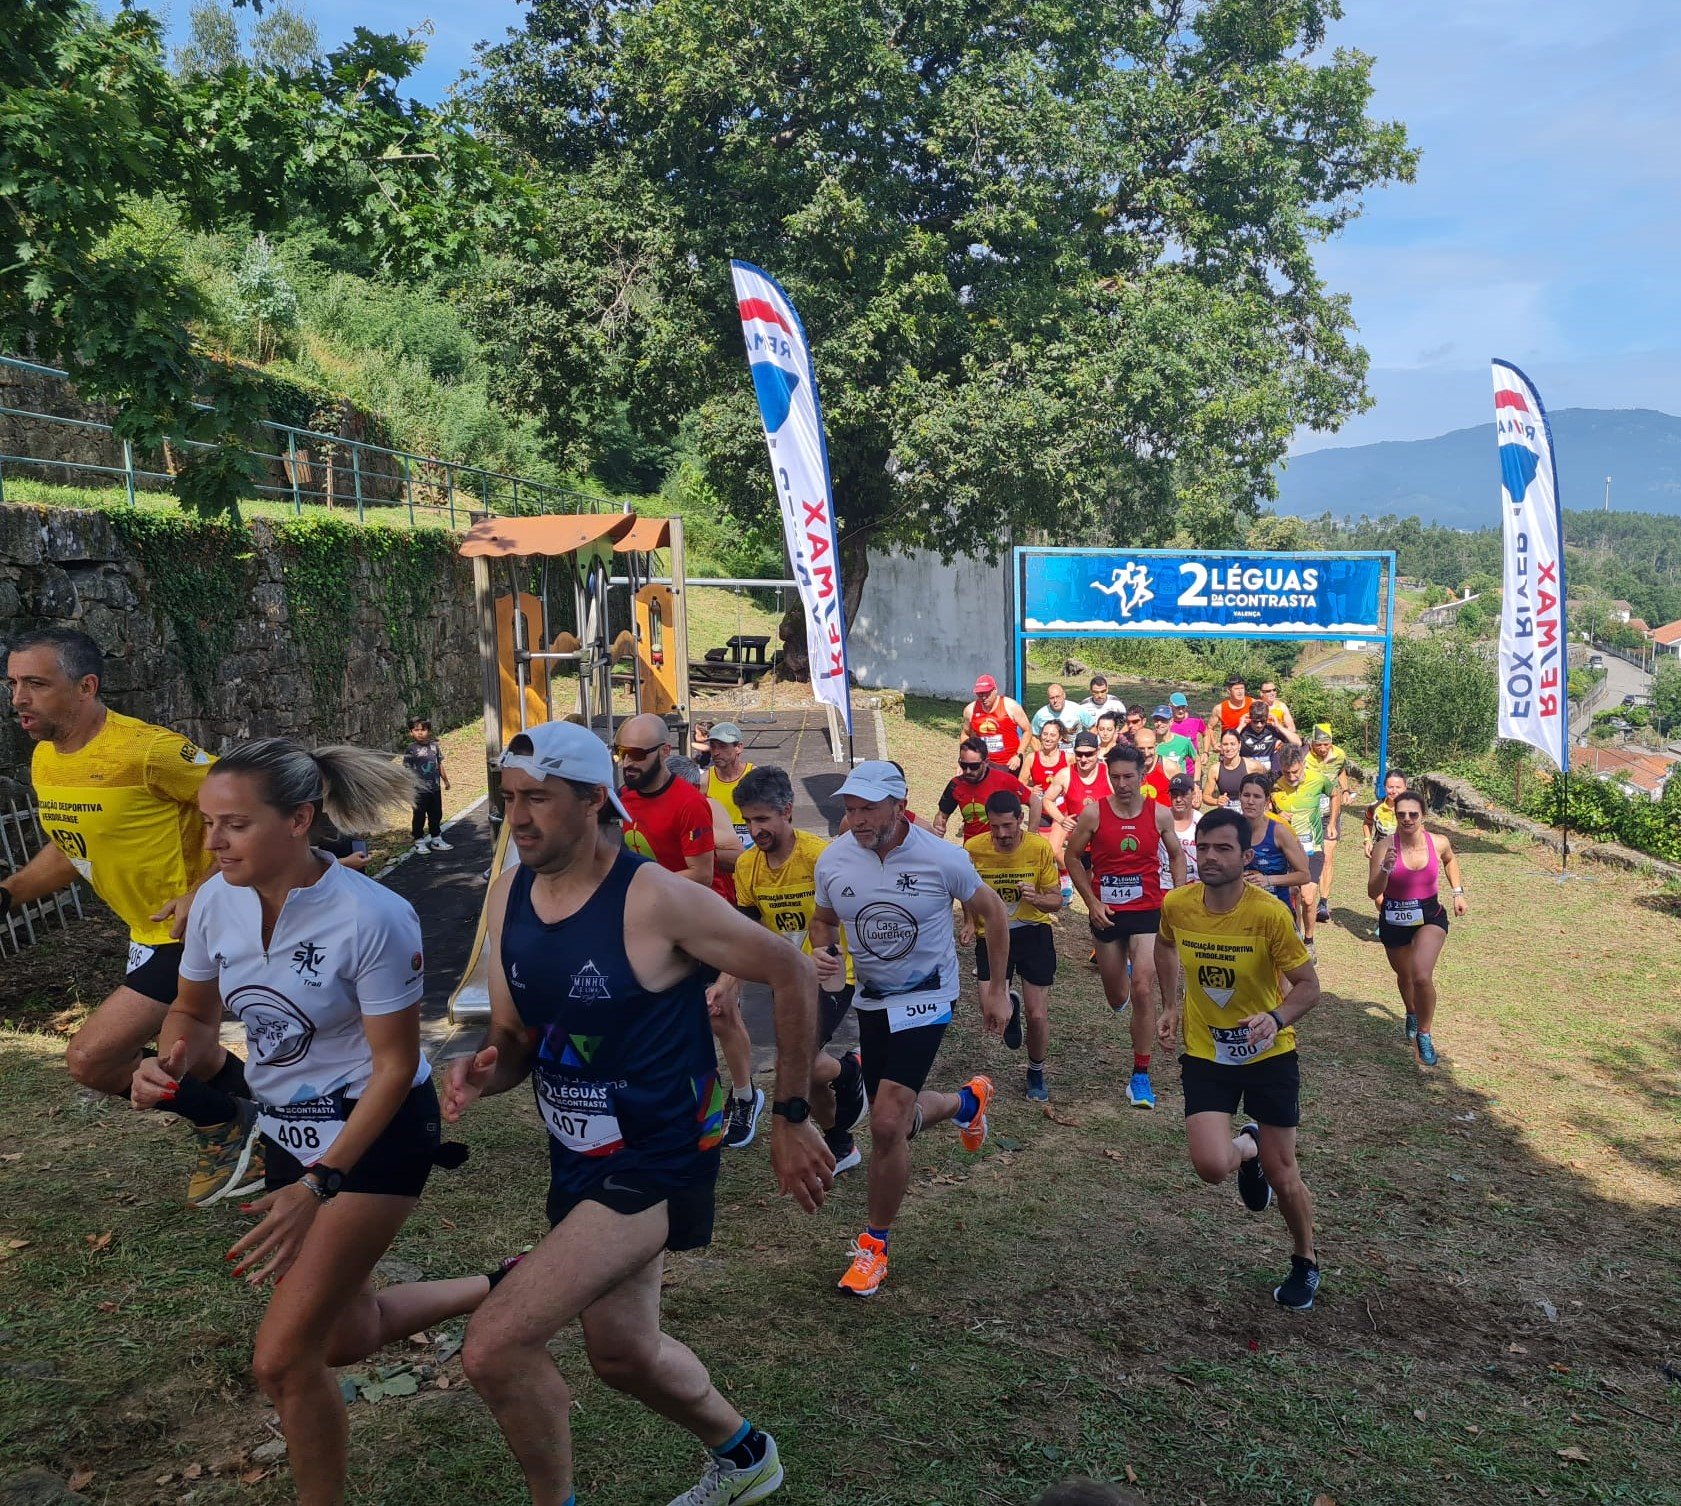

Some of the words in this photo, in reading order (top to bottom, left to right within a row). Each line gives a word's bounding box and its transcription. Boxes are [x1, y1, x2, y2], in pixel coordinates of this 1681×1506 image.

[1177, 561, 1208, 606] 2
[1211, 563, 1318, 592] LÉGUAS
[1211, 594, 1225, 602] DA
[1224, 593, 1318, 608] CONTRASTA
[1233, 610, 1261, 618] VALENÇA
[58, 802, 103, 813] DESPORTIVA
[1111, 888, 1131, 898] 414
[1394, 911, 1413, 921] 206
[876, 919, 898, 931] Casa
[867, 929, 912, 940] Lourenço
[1181, 938, 1216, 951] ASSOCIAÇÃO
[1216, 944, 1254, 953] DESPORTIVA
[573, 977, 605, 987] MINHO
[1224, 1030, 1235, 1041] 2
[1227, 1044, 1258, 1057] 200
[553, 1084, 608, 1100] LÉGUAS
[560, 1099, 608, 1109] CONTRASTA
[291, 1106, 336, 1114] CONTRASTA
[552, 1111, 588, 1139] 407
[278, 1124, 321, 1149] 408
